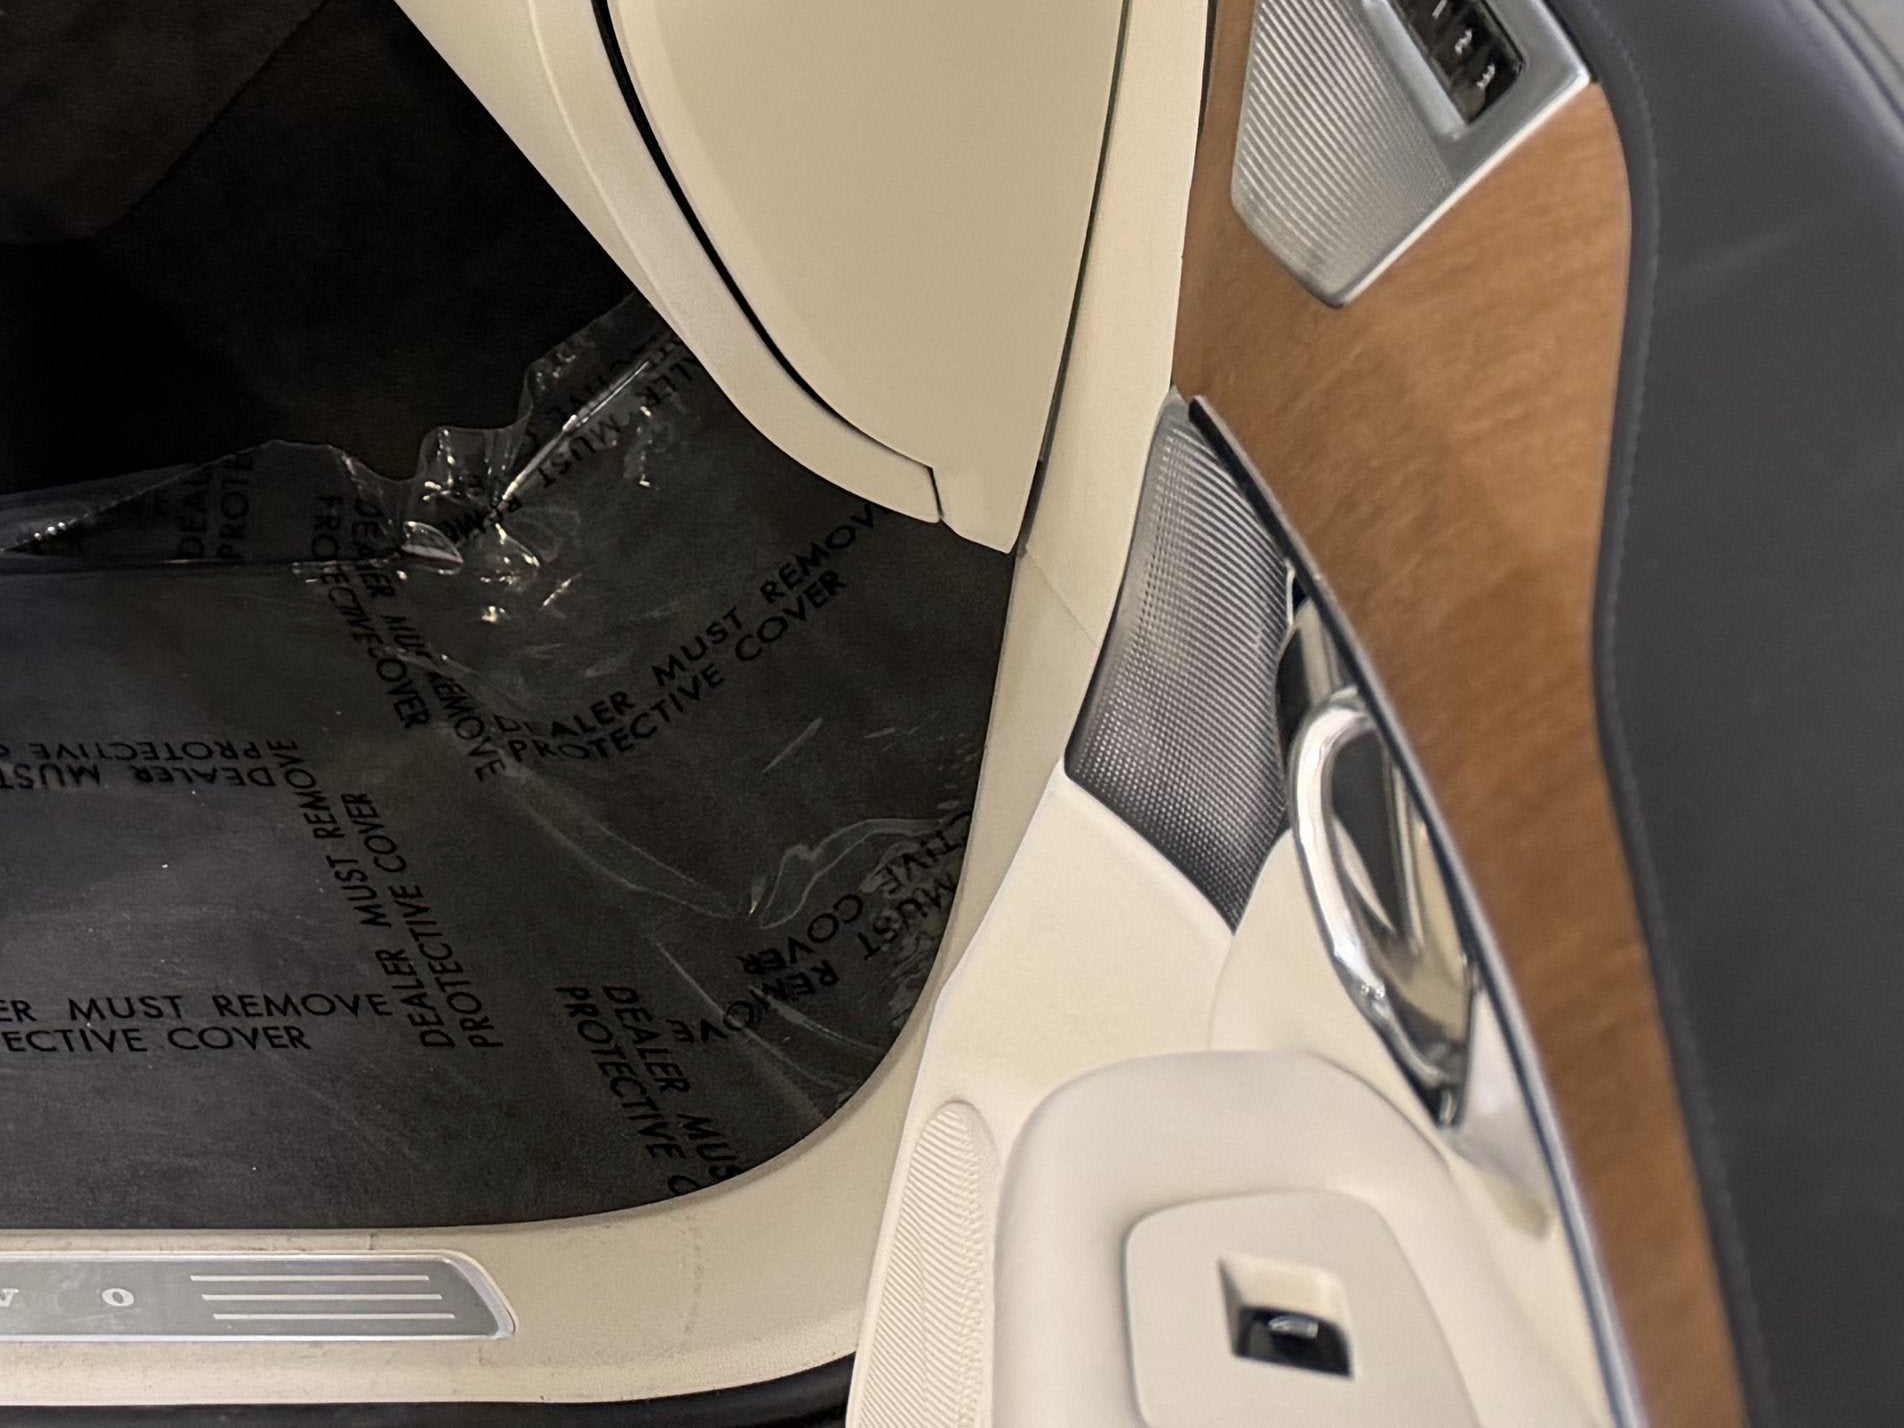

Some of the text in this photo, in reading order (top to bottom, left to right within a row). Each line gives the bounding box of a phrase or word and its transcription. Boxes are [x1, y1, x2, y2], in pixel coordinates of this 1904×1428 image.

[309, 496, 386, 646] PROECTIVE
[651, 606, 744, 687] MUST
[759, 504, 880, 604] REMOV
[507, 568, 848, 763] PROTECTIVE COVER
[30, 740, 265, 762] PROTECTIVE
[130, 763, 277, 788] DEALER
[265, 739, 456, 1051] DEALER MUST REMOVE
[340, 791, 506, 1050] PROTECTIVE COVER
[736, 893, 865, 977] COVER
[67, 993, 188, 1022] MUST
[210, 991, 395, 1019] REMOVE
[166, 1023, 312, 1052] COVER
[602, 986, 692, 1094] DEALER
[554, 986, 686, 1161] PROTECTIVE
